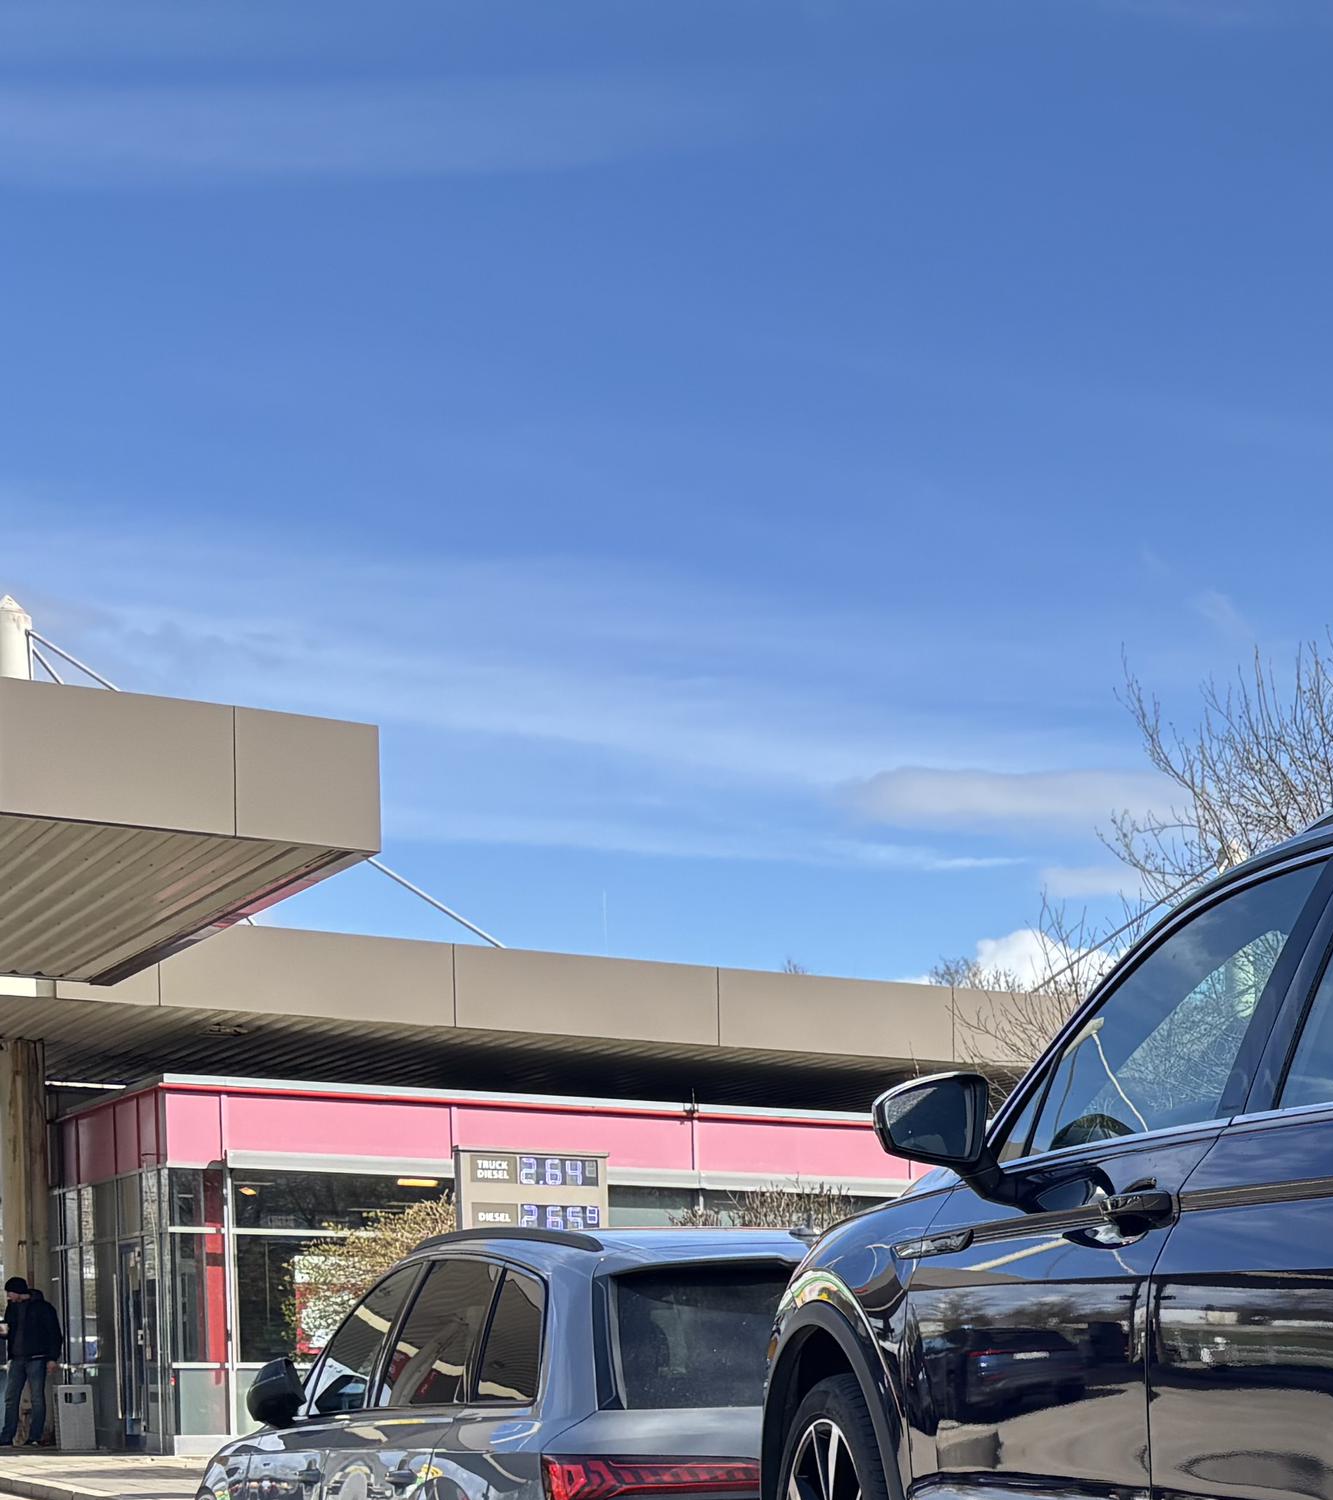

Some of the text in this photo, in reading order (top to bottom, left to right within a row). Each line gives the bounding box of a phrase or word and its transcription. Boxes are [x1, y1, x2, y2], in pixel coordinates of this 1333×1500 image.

[476, 1159, 508, 1170] TRUCK
[476, 1169, 509, 1179] DIESEL
[478, 1212, 512, 1222] DIESEL
